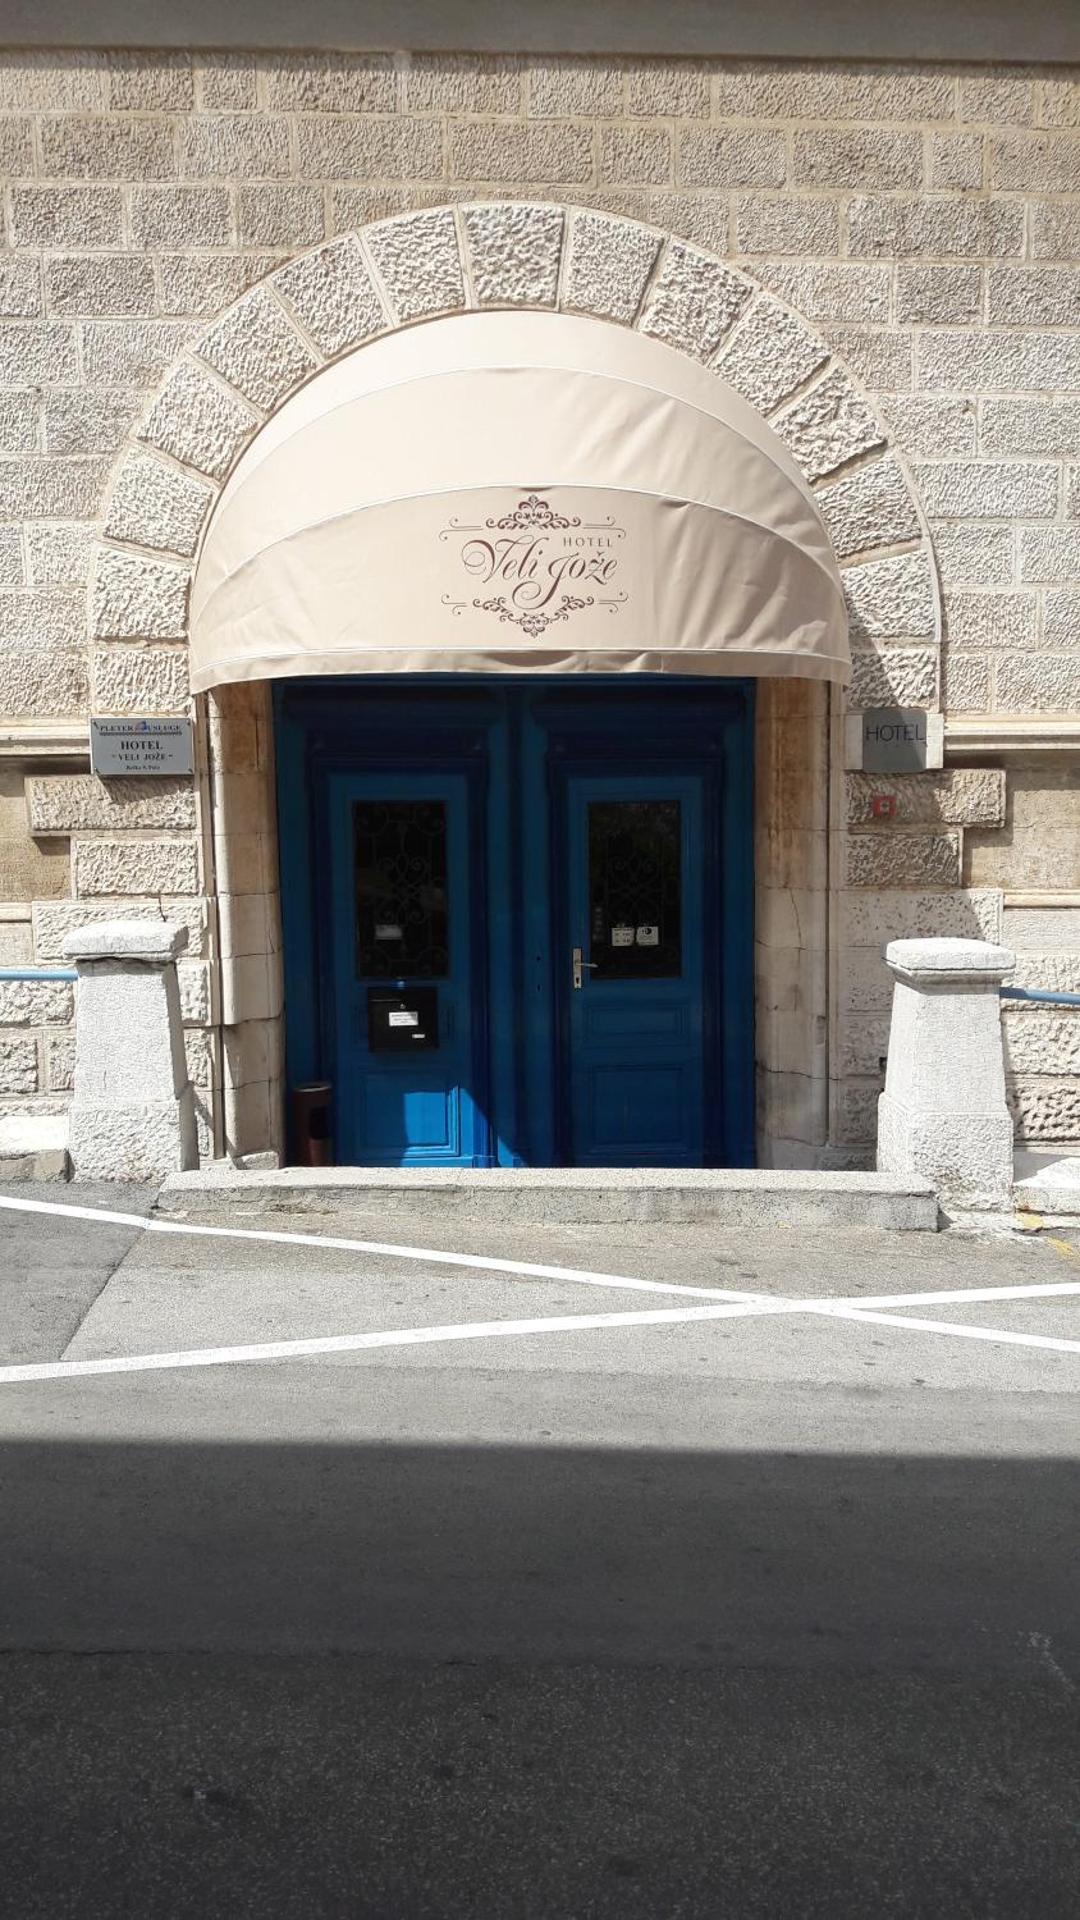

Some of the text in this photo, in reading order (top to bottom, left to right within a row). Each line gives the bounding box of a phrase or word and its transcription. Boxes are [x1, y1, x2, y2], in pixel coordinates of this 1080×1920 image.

[563, 536, 613, 548] HOTEL
[461, 534, 618, 610] Veli Jože
[866, 724, 927, 743] HOTEL
[120, 740, 163, 750] HOTEL
